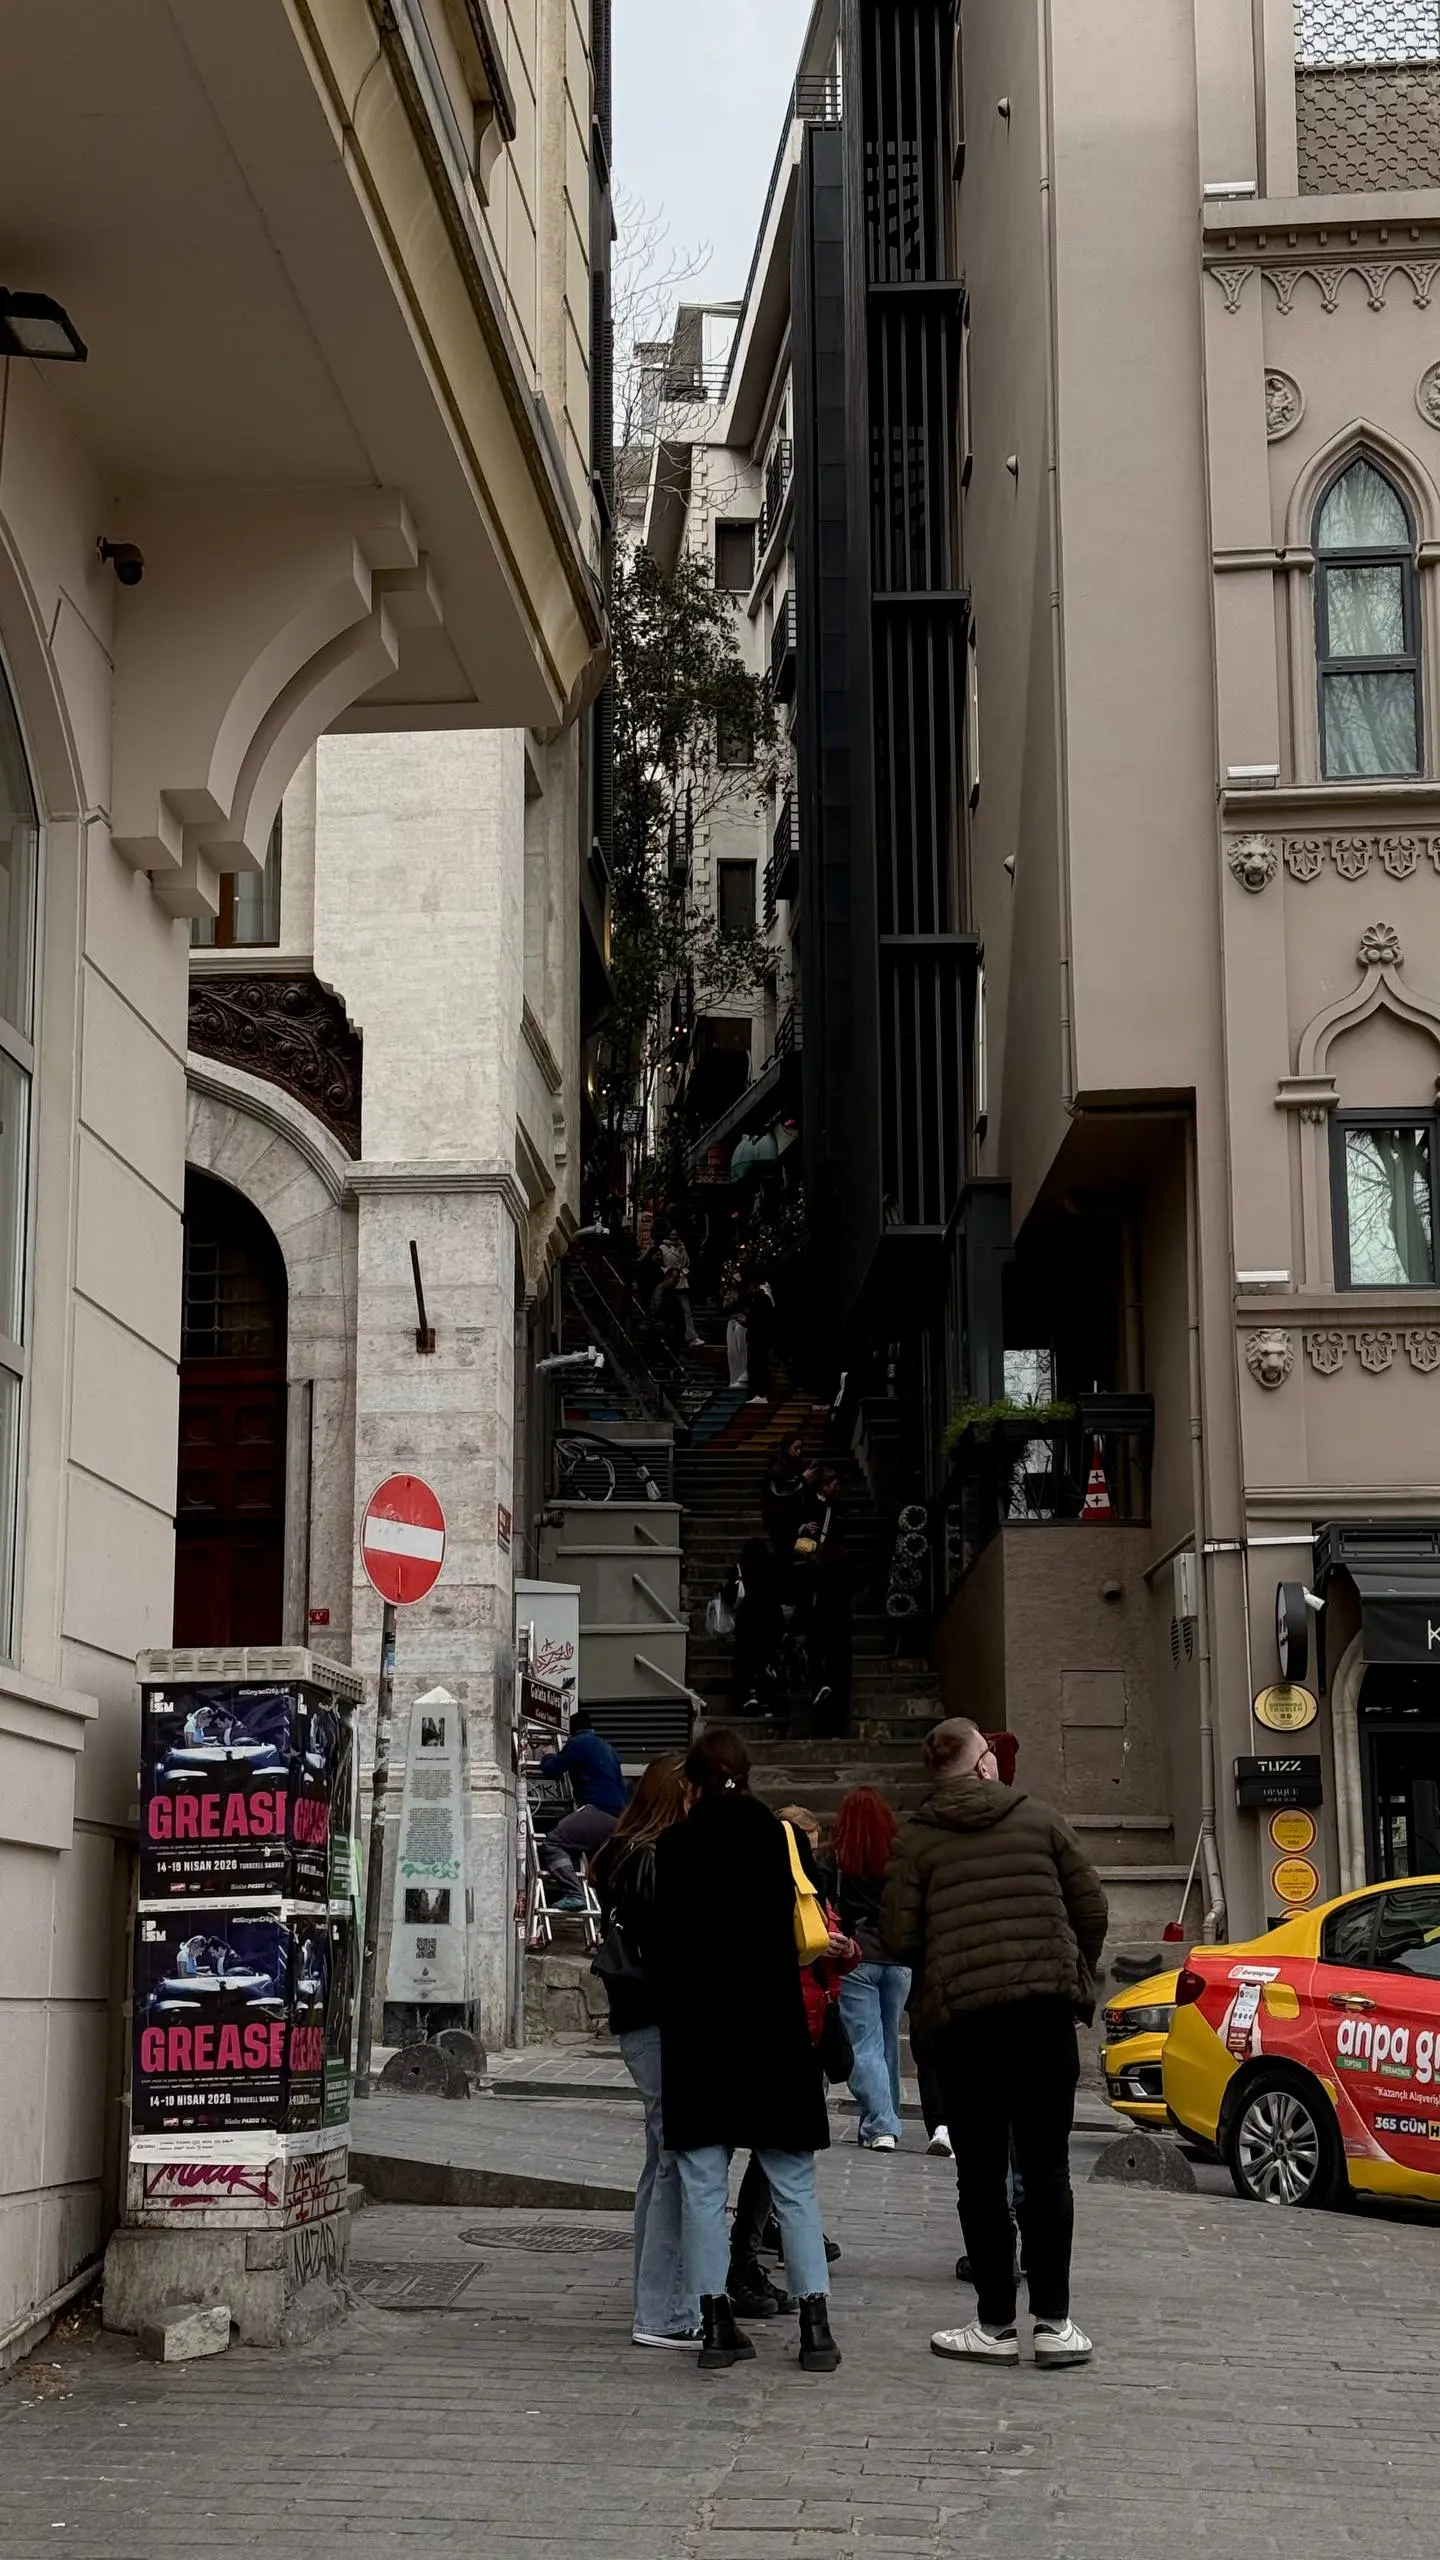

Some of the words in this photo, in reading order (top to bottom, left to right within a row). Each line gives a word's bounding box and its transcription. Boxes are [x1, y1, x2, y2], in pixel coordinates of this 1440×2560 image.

[1258, 1760, 1301, 1772] TUZZ
[1337, 2019, 1410, 2073] anpa
[1409, 2091, 1440, 2107] Alışveriş
[1375, 2116, 1397, 2130] 365
[1400, 2117, 1427, 2134] GÜN
